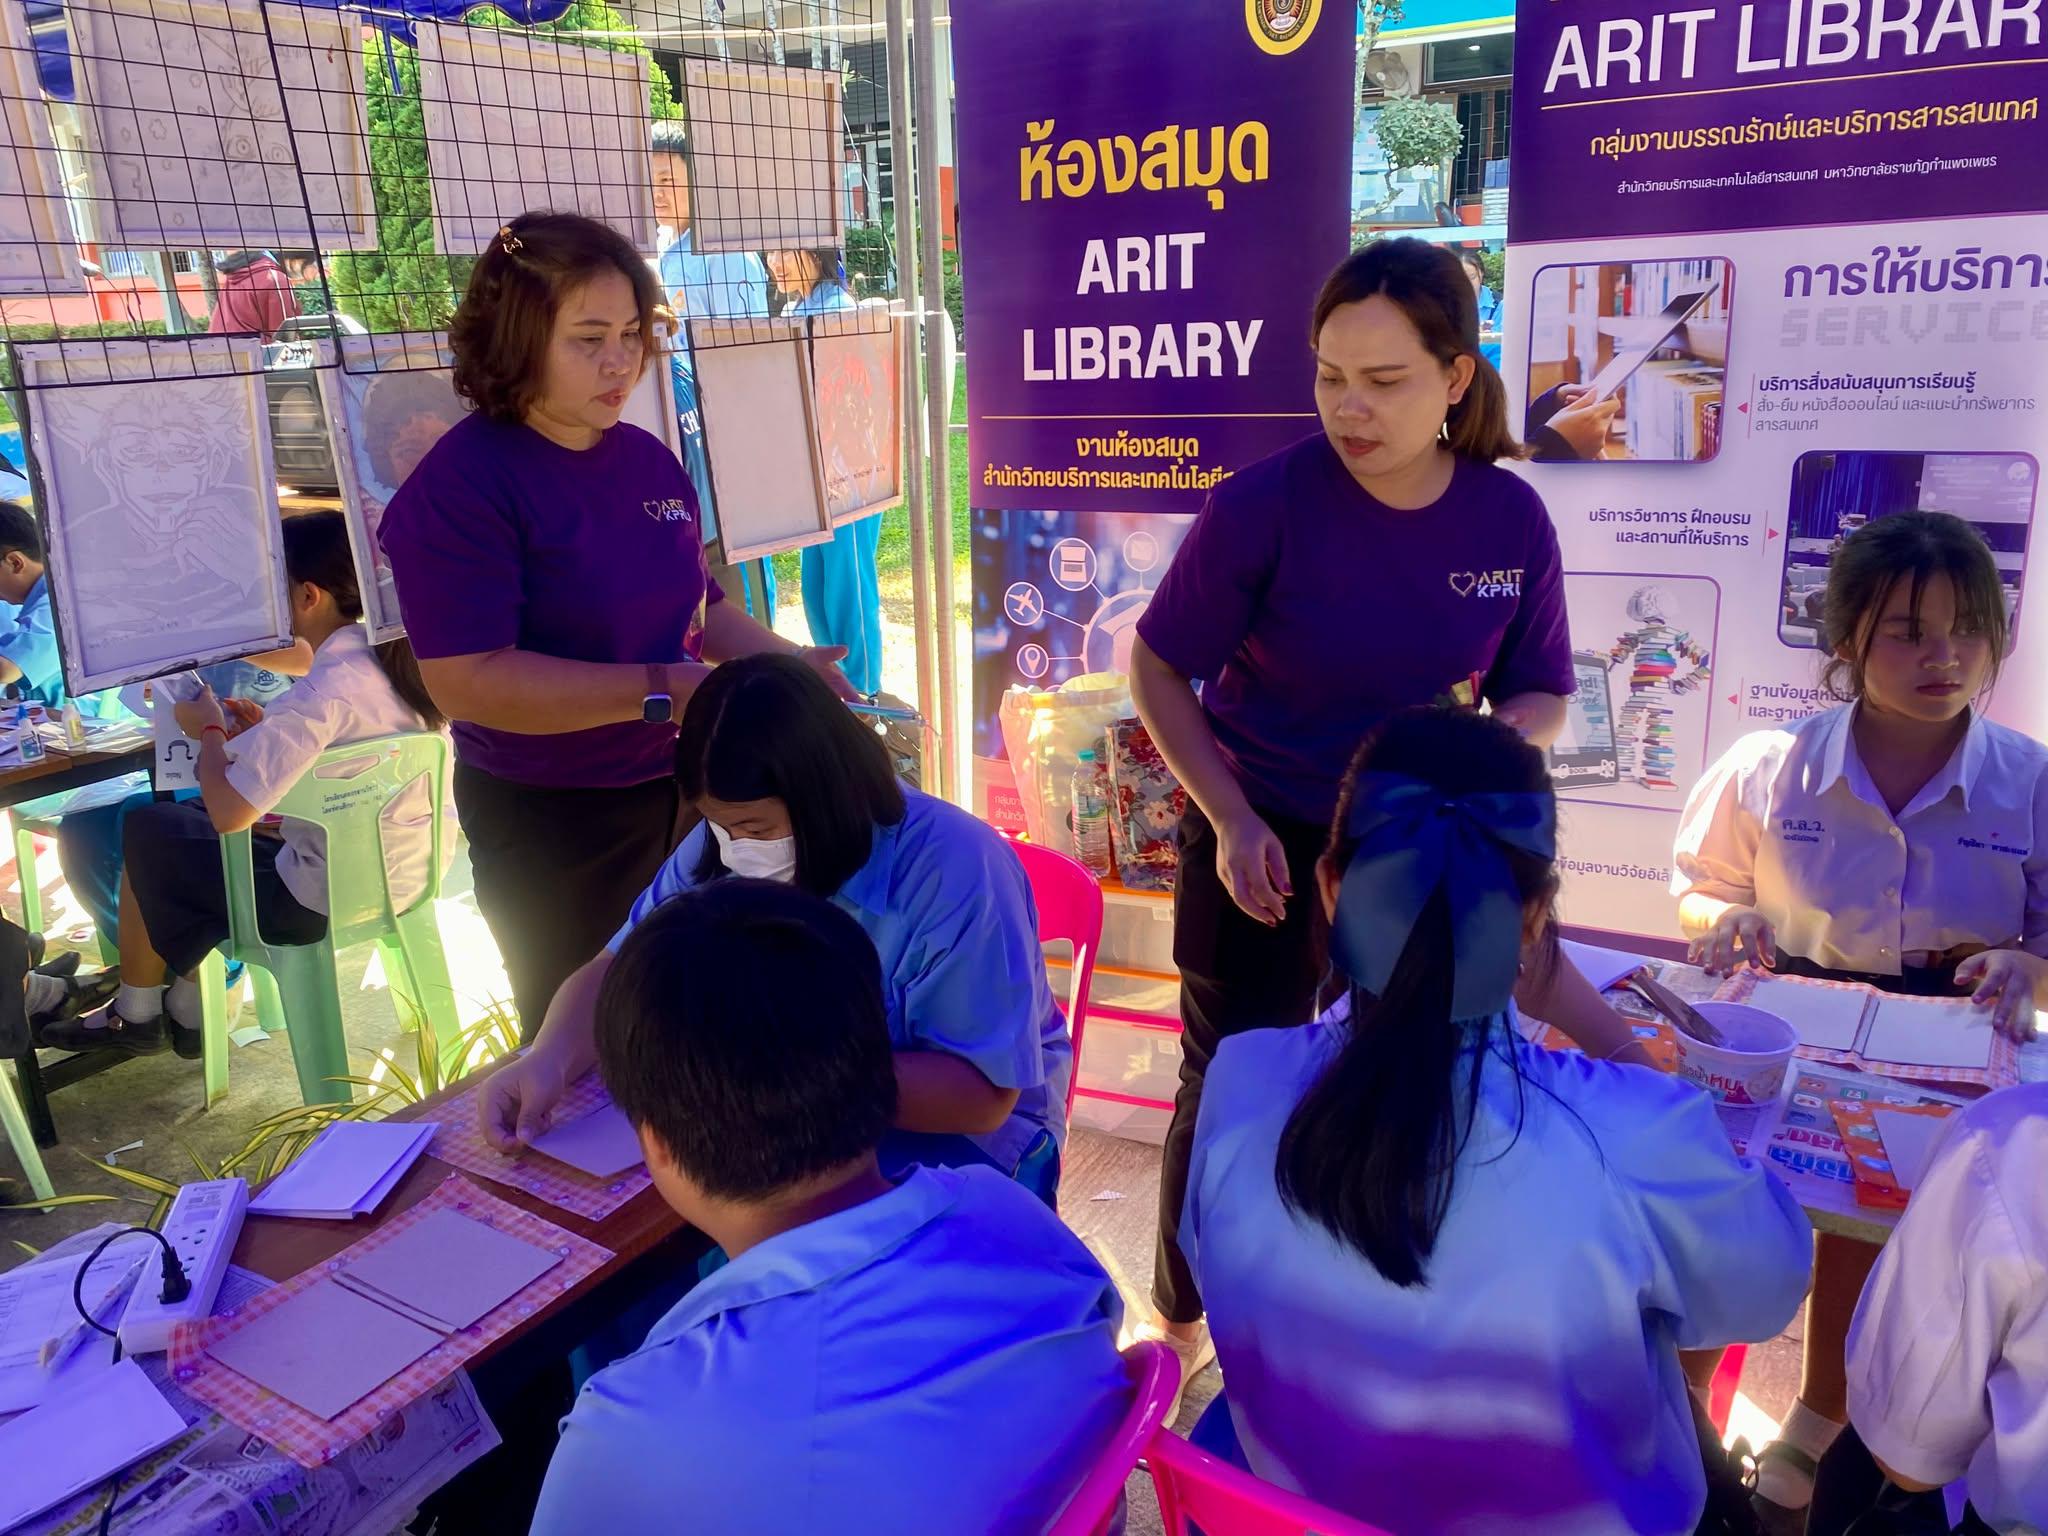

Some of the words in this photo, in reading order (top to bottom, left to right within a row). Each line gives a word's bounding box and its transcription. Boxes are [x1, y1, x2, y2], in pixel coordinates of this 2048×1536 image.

[1543, 8, 1716, 93] ARIT
[1736, 0, 2042, 73] LIBRAR
[1590, 97, 2039, 161] กลุ่มงานบรรณรักษ์และบริการสารสนเทศ
[1020, 118, 1270, 211] ห้องสมุด
[1617, 168, 1819, 194] สำนักวิทยบริการและเทคโนโลยีสารสนเทศ
[1076, 231, 1206, 295] ARIT
[1784, 245, 2048, 297] การให้บริกา
[1023, 319, 1264, 382] LIBRARY
[1759, 371, 1977, 394] บริการสิ่งสนับสนุนการเรียนรู้
[1755, 418, 1819, 431] สารสนเทศ
[1076, 430, 1199, 464] งานห้องสมุด
[983, 463, 1235, 489] สำนักวิทยบริการและเทคโนโลยี
[1589, 508, 1687, 523] บริการวิชาการ
[1691, 509, 1751, 525] ฝึกอบรม
[1616, 526, 1750, 546] และสถานที่ให้บริการ
[1478, 568, 1525, 585] ARIT
[1554, 855, 1671, 882] ข้อมูลงานวิจัยอิเล็
